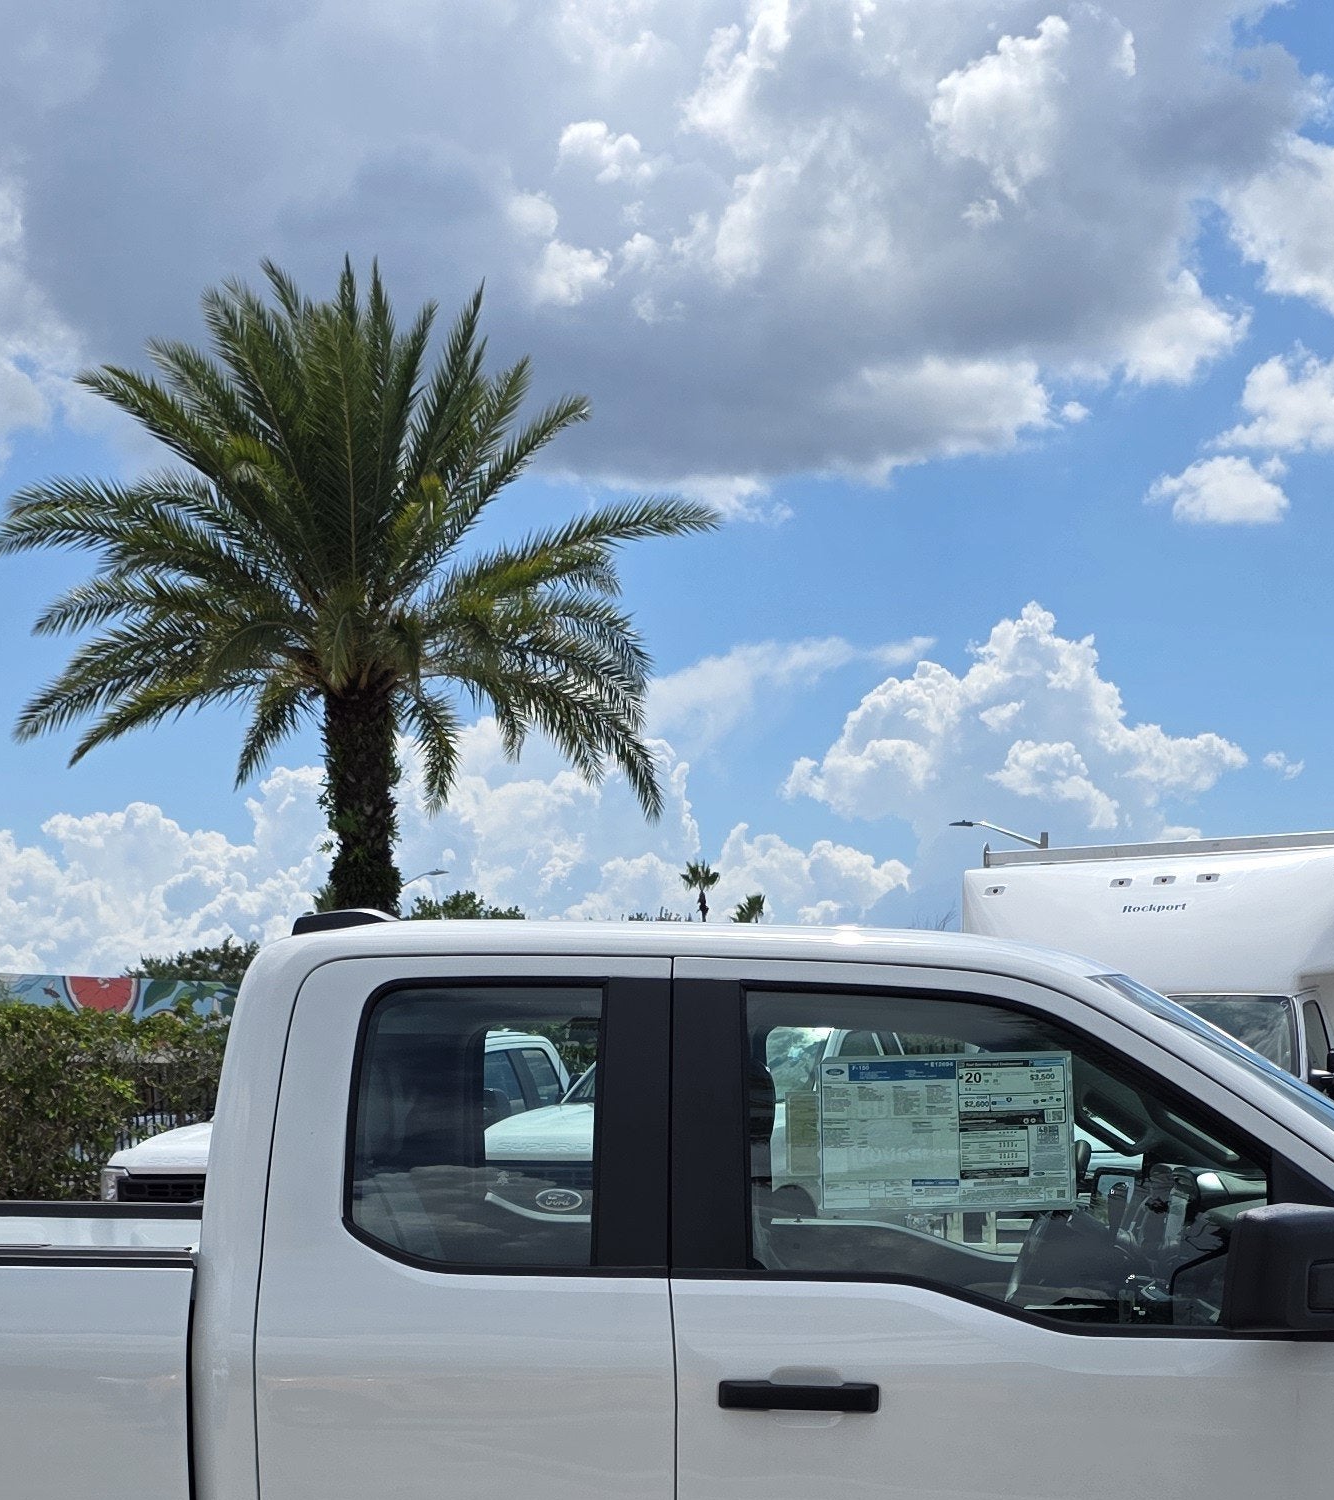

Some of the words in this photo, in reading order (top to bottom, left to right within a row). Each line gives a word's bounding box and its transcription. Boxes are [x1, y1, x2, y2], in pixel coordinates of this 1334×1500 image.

[1122, 903, 1187, 914] Rockport
[964, 1072, 982, 1084] 20
[1029, 1073, 1056, 1081] $3,500
